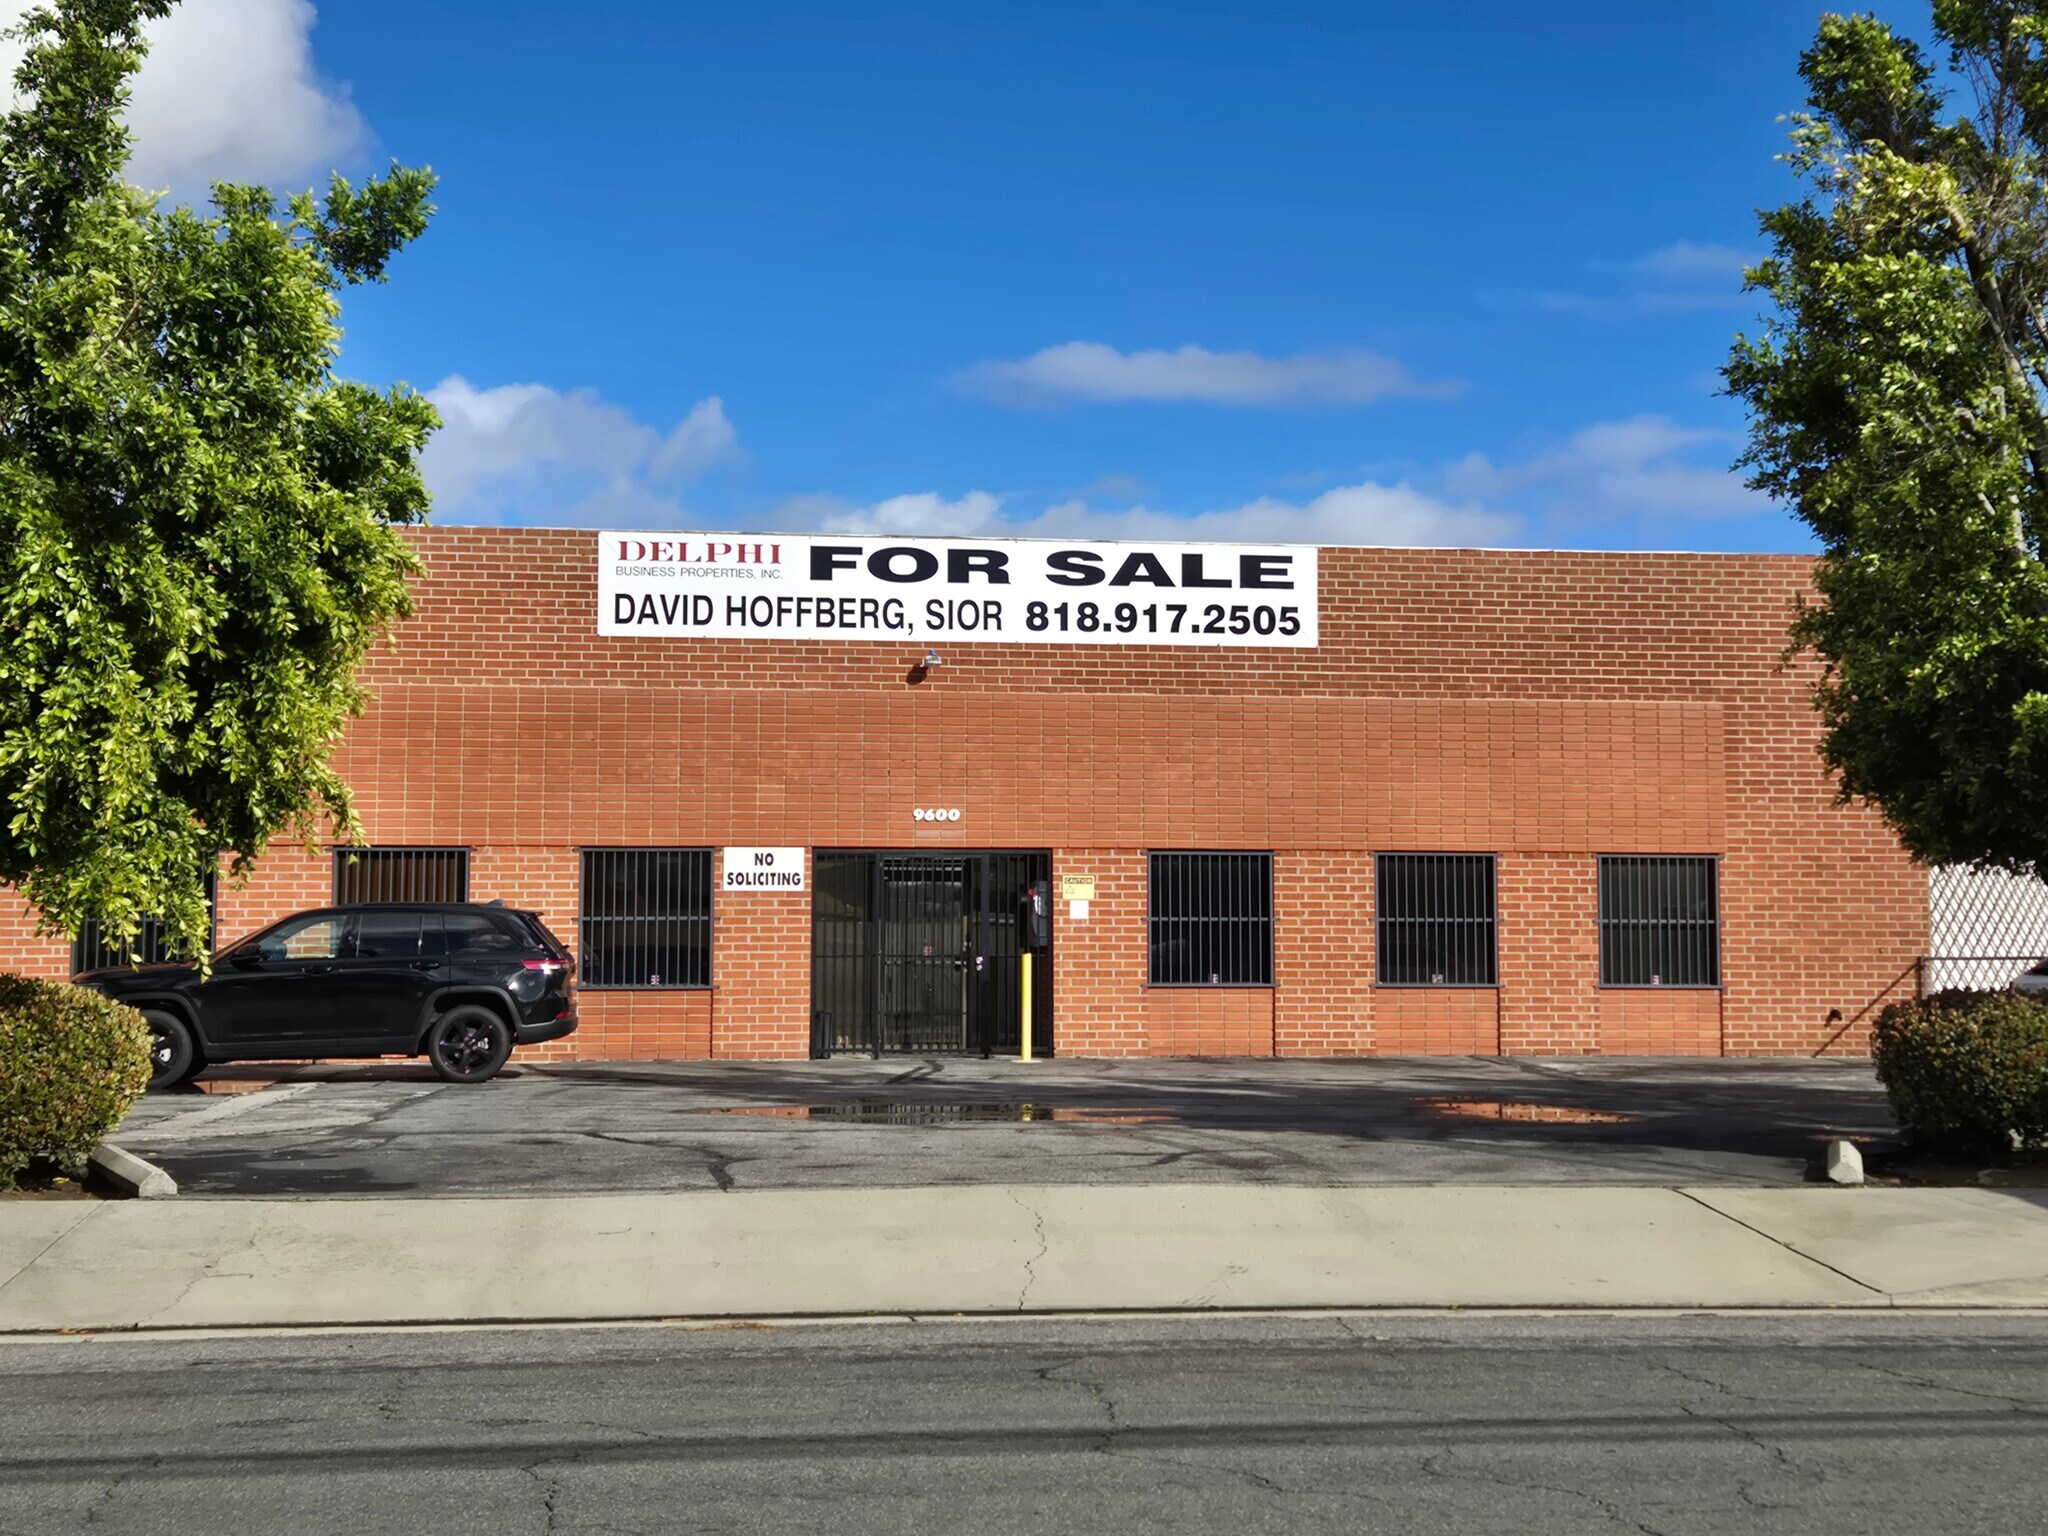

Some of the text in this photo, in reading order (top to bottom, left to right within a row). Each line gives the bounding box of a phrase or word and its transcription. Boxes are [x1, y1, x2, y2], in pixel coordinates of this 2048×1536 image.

[618, 541, 782, 564] DELPHI
[615, 566, 783, 580] BUSINESS PROPERTIES, INC.
[809, 545, 1295, 590] FOR SALE
[614, 593, 1301, 636] DAVID HOFFBERG, SIOR 818.917.2505
[913, 808, 961, 822] 9600
[754, 852, 774, 867] NO
[726, 872, 801, 887] SOLICITING
